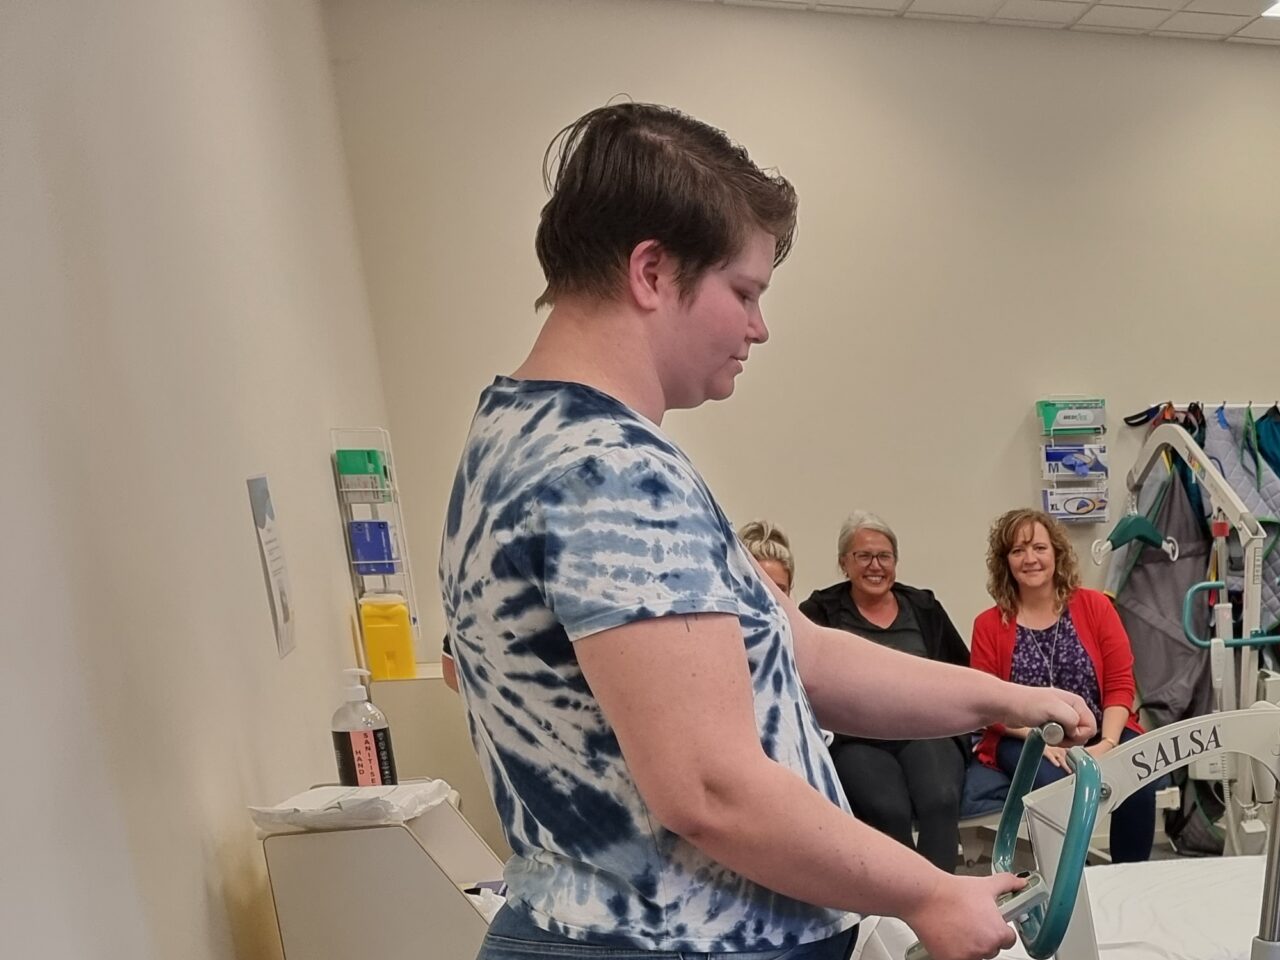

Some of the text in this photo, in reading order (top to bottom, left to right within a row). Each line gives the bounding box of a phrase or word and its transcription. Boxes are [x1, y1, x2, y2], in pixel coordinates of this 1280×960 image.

[1048, 463, 1059, 473] M
[1050, 503, 1060, 511] XL
[355, 749, 365, 775] HAND
[1131, 725, 1223, 781] SALSA
